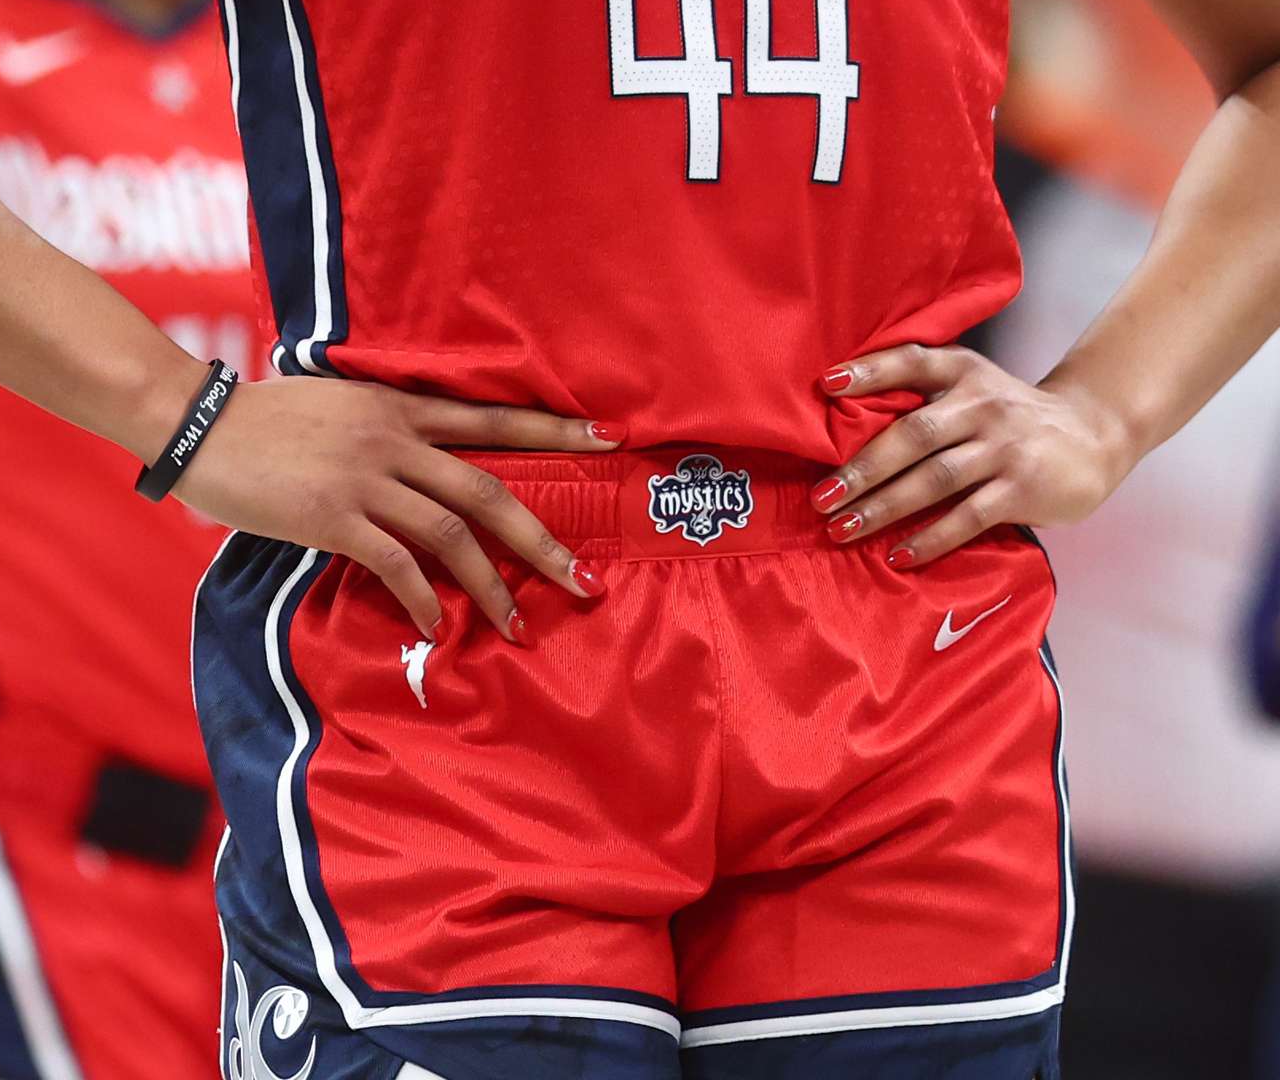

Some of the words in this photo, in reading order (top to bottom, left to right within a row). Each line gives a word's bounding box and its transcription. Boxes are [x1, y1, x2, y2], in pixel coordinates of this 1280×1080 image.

[199, 381, 227, 412] God,
[196, 411, 209, 427] I
[171, 424, 203, 466] Win!
